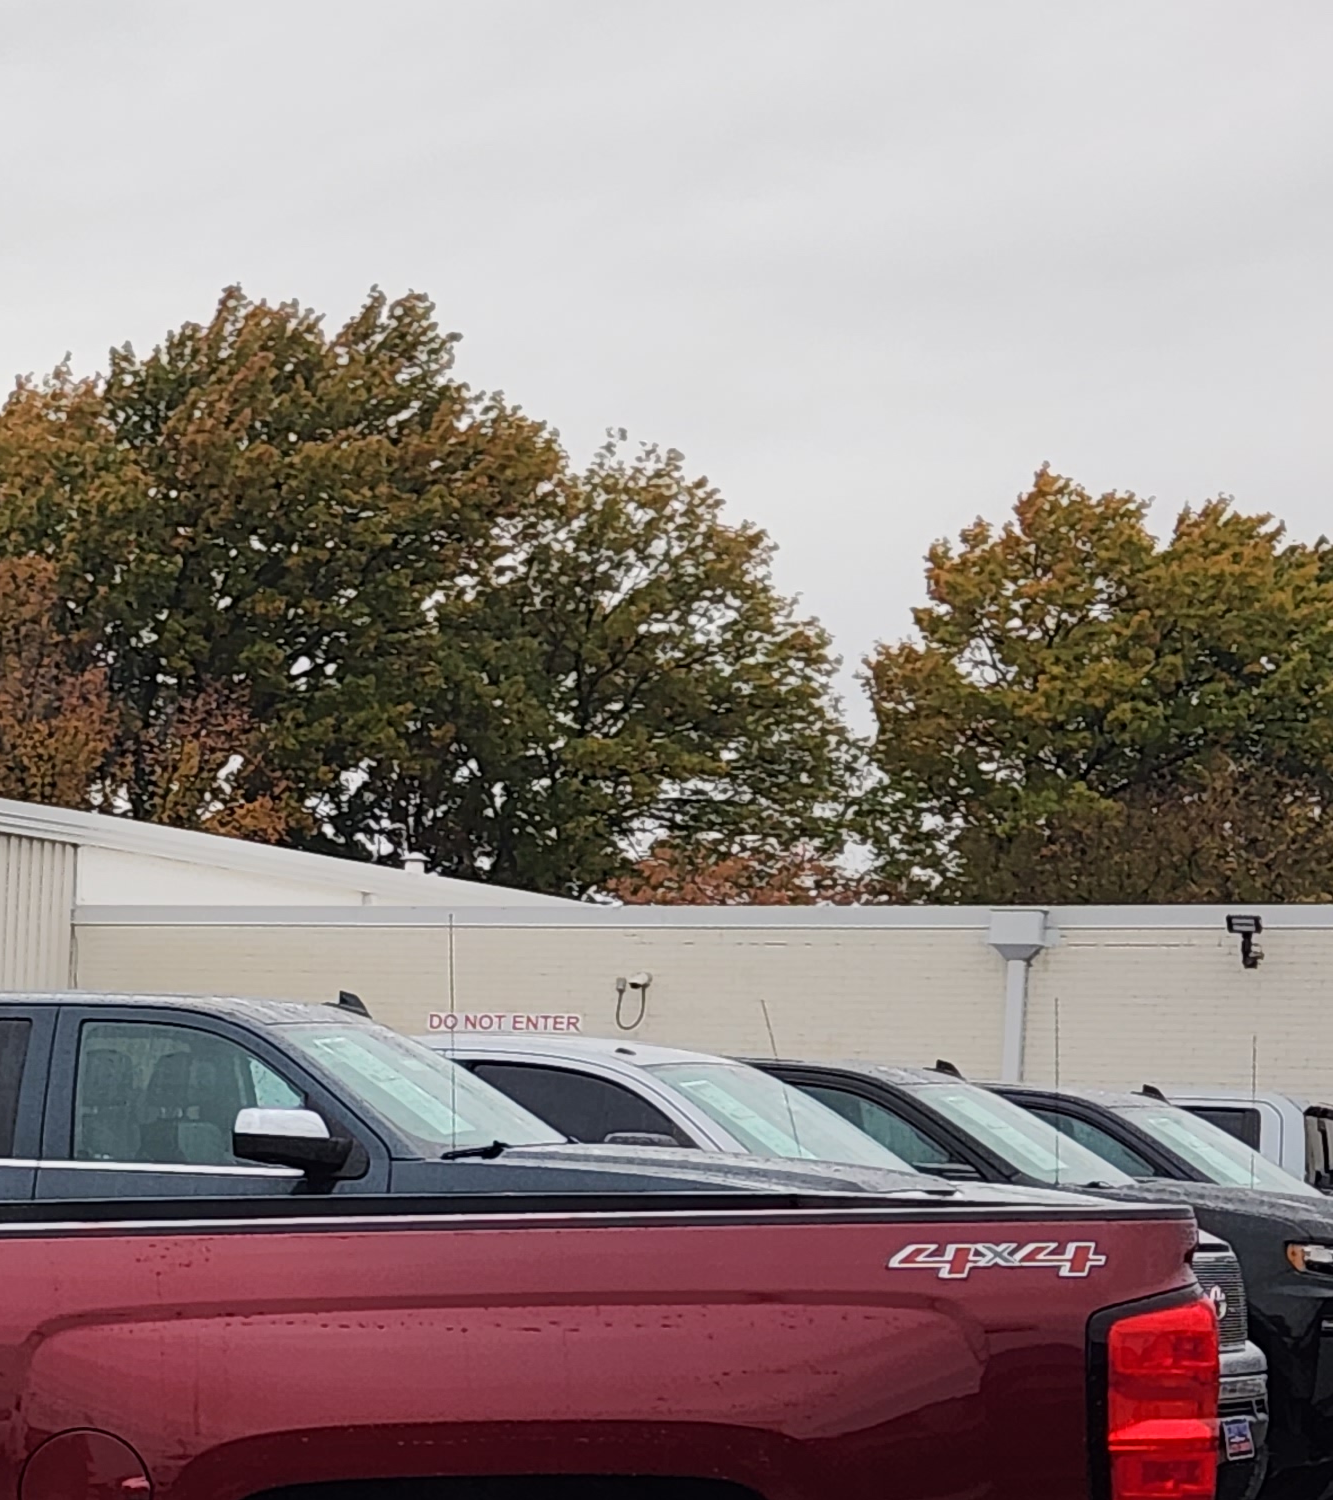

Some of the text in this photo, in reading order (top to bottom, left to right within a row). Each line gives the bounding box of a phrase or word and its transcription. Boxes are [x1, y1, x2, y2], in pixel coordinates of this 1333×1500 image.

[429, 1014, 581, 1032] DO NOT ENTER
